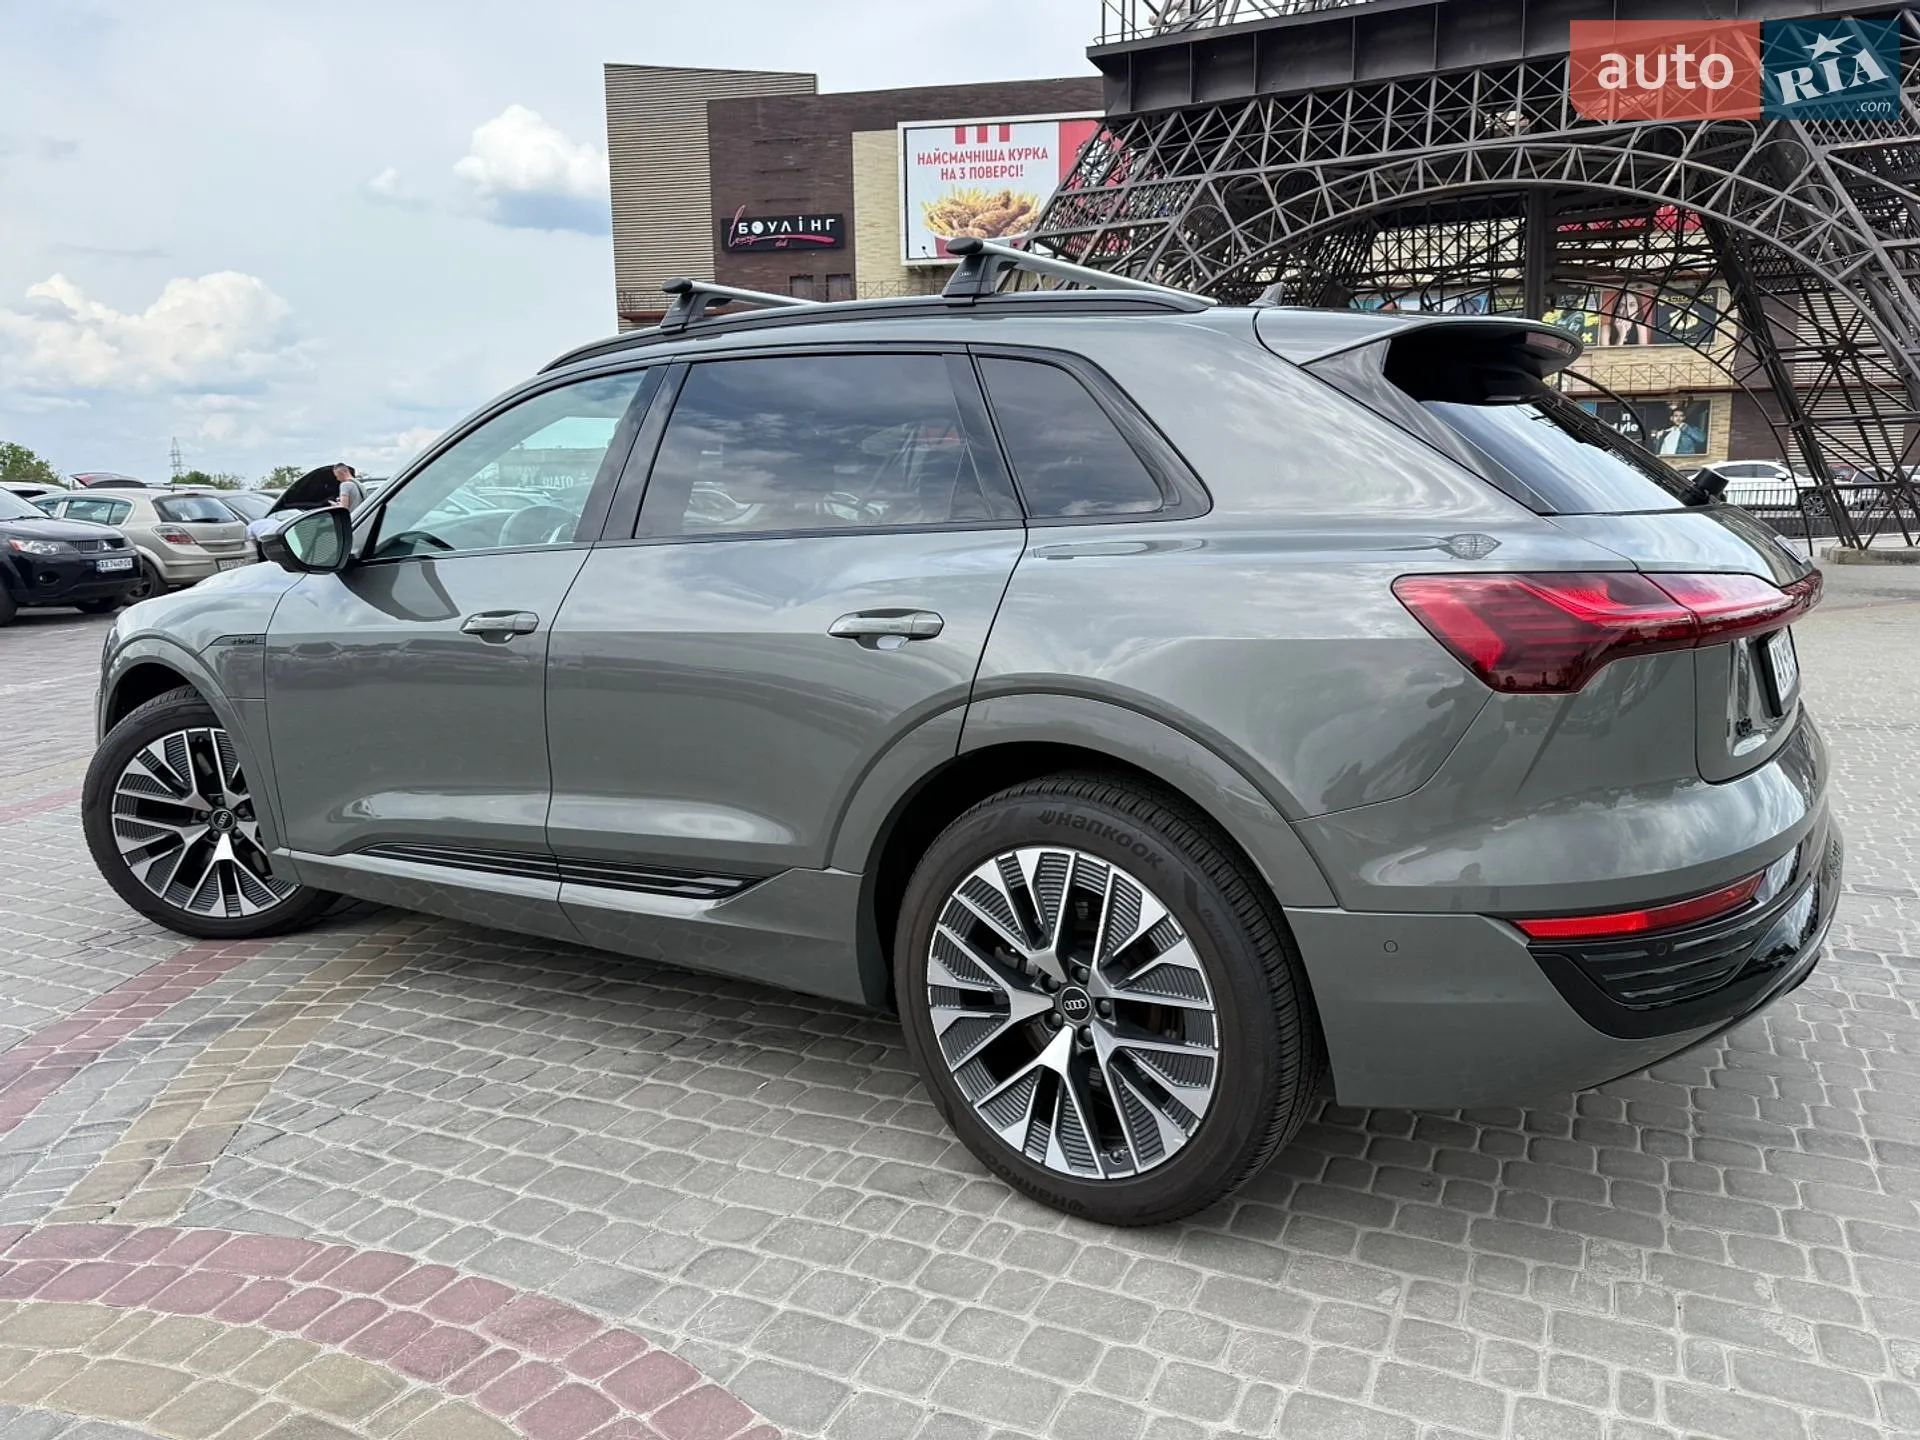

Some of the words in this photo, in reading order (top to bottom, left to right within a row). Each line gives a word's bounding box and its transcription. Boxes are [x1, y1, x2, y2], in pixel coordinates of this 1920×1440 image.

[917, 147, 1005, 166] НАЙСМАЧНІША
[1008, 146, 1049, 161] КУРКА
[941, 168, 957, 181] НА
[959, 167, 966, 180] 3
[969, 164, 1024, 179] ПОВЕРСІ!
[738, 216, 836, 235] БОУЛІНГ
